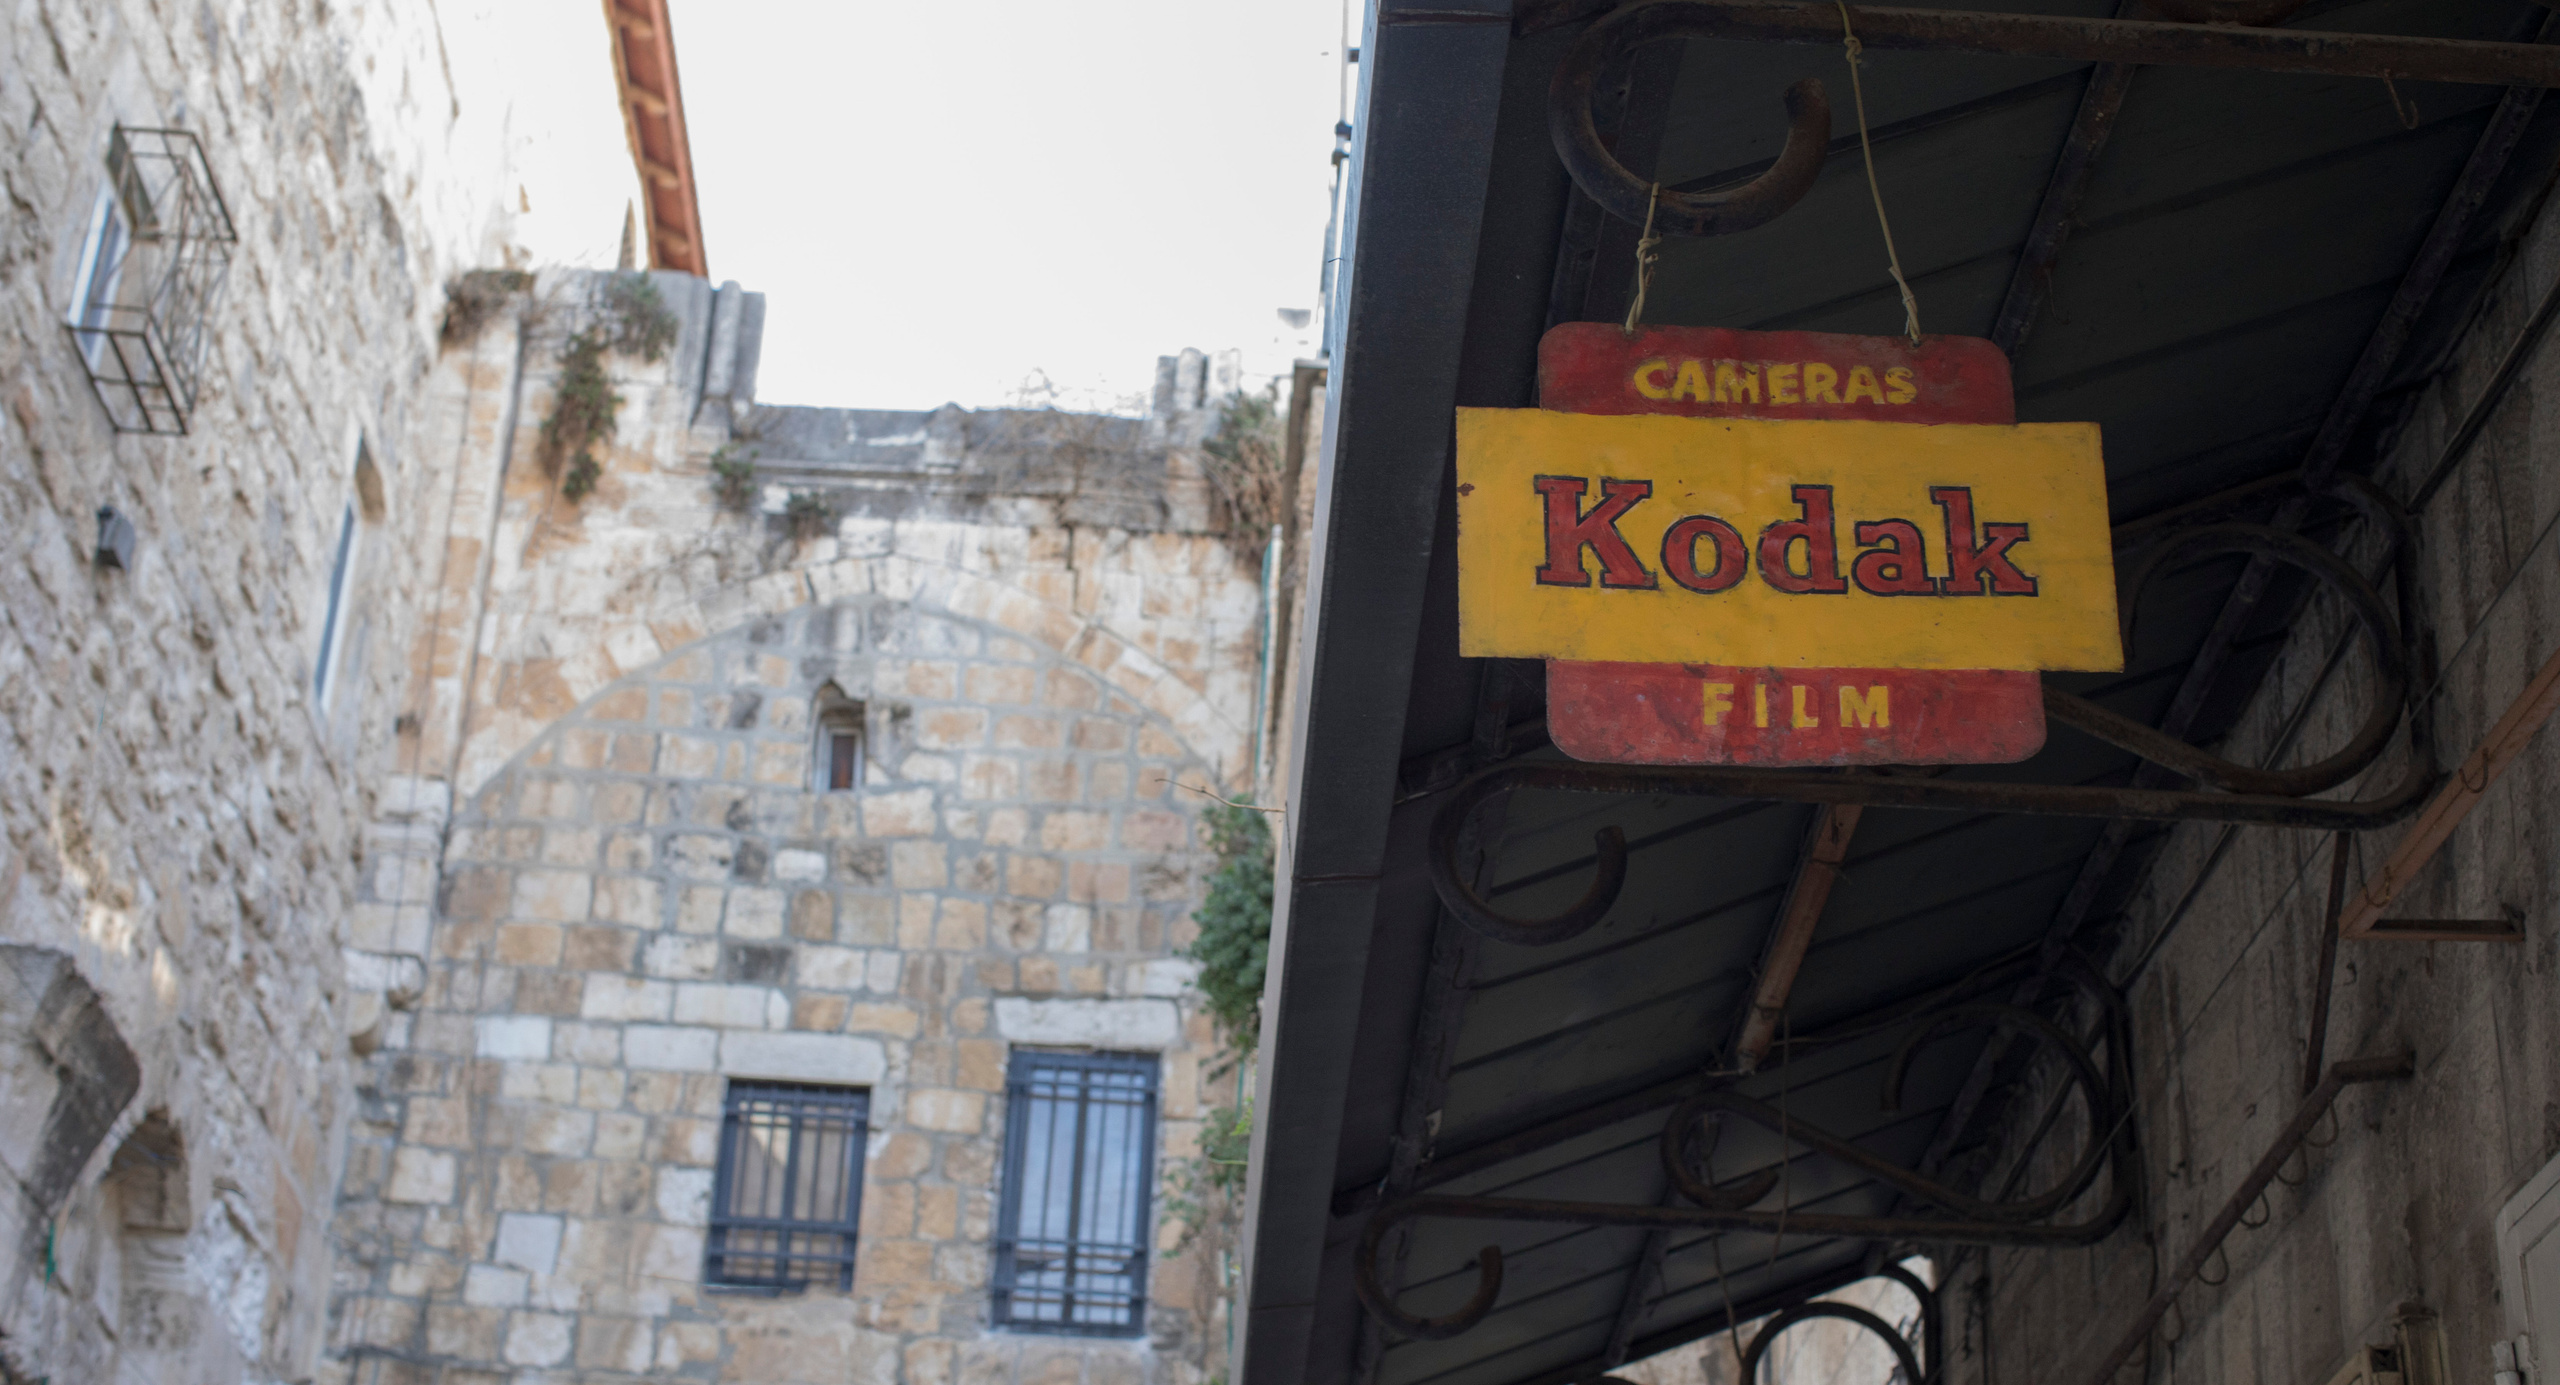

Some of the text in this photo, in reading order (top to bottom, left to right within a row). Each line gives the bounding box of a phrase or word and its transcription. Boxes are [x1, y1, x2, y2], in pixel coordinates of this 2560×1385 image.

[1632, 359, 1918, 405] CAMERAS
[1534, 474, 2039, 597] Kodak
[1703, 682, 1889, 729] FILM
